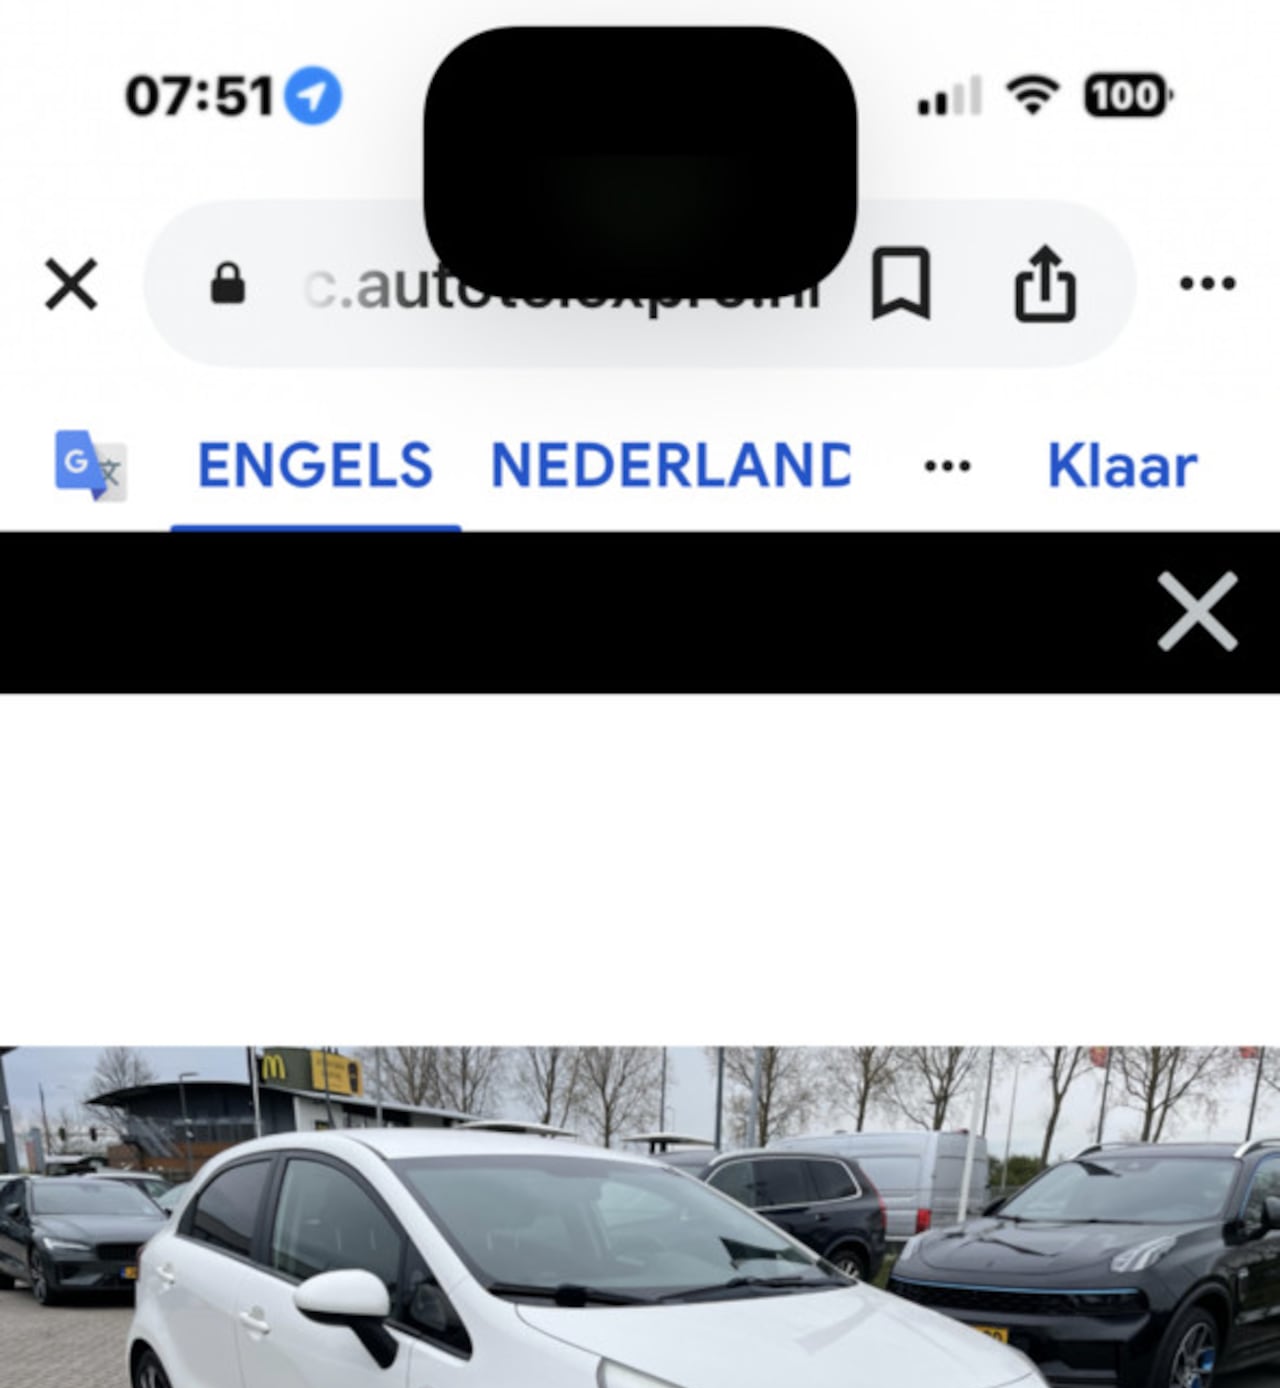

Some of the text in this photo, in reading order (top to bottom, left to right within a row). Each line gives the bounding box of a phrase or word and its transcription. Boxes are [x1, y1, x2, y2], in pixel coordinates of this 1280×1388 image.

[125, 75, 273, 117] 07:51
[1091, 79, 1160, 111] 100
[64, 448, 88, 474] G
[199, 441, 851, 489] ENGELS NEDERLAND
[1049, 442, 1199, 489] Klaar
